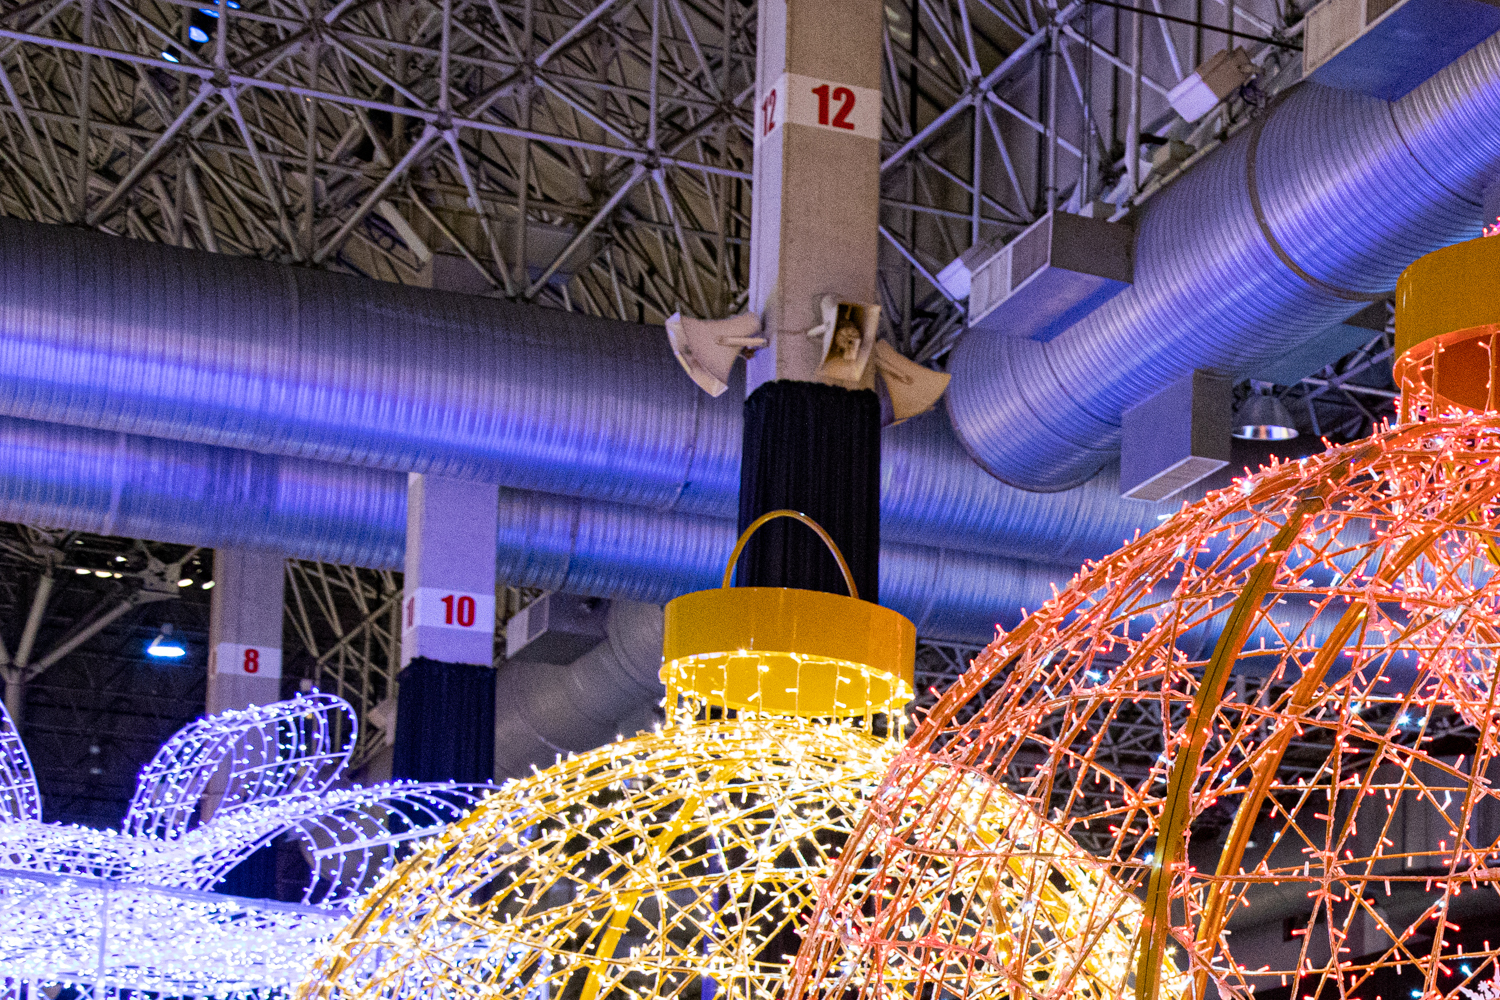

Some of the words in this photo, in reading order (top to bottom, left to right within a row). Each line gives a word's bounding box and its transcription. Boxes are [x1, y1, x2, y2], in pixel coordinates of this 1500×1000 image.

[762, 88, 777, 136] 12
[811, 84, 856, 131] 12
[441, 595, 476, 627] 10
[243, 648, 259, 674] 8
